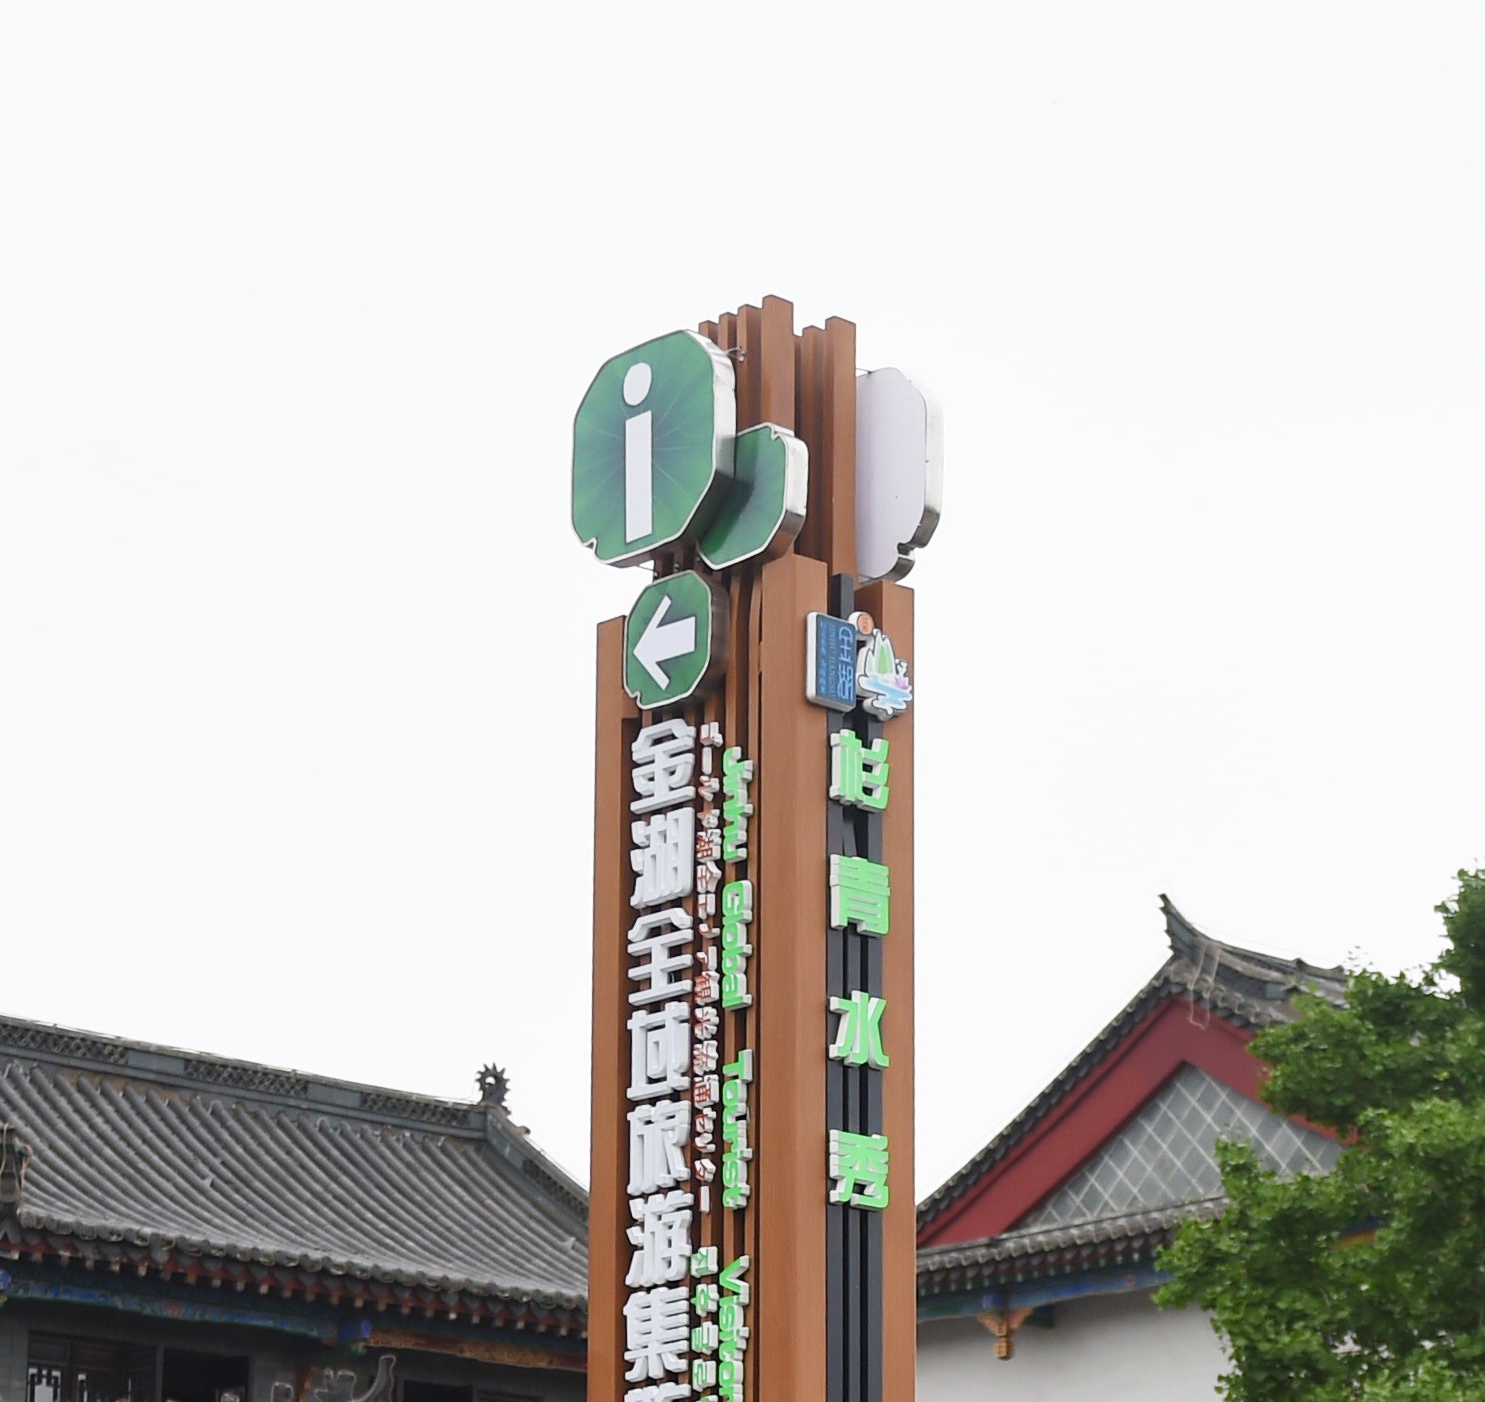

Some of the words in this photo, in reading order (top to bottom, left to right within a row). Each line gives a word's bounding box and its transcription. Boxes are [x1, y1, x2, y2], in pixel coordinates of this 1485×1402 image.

[723, 746, 754, 864] Jinhu
[722, 879, 753, 1010] Global
[722, 1048, 753, 1210] Tourist
